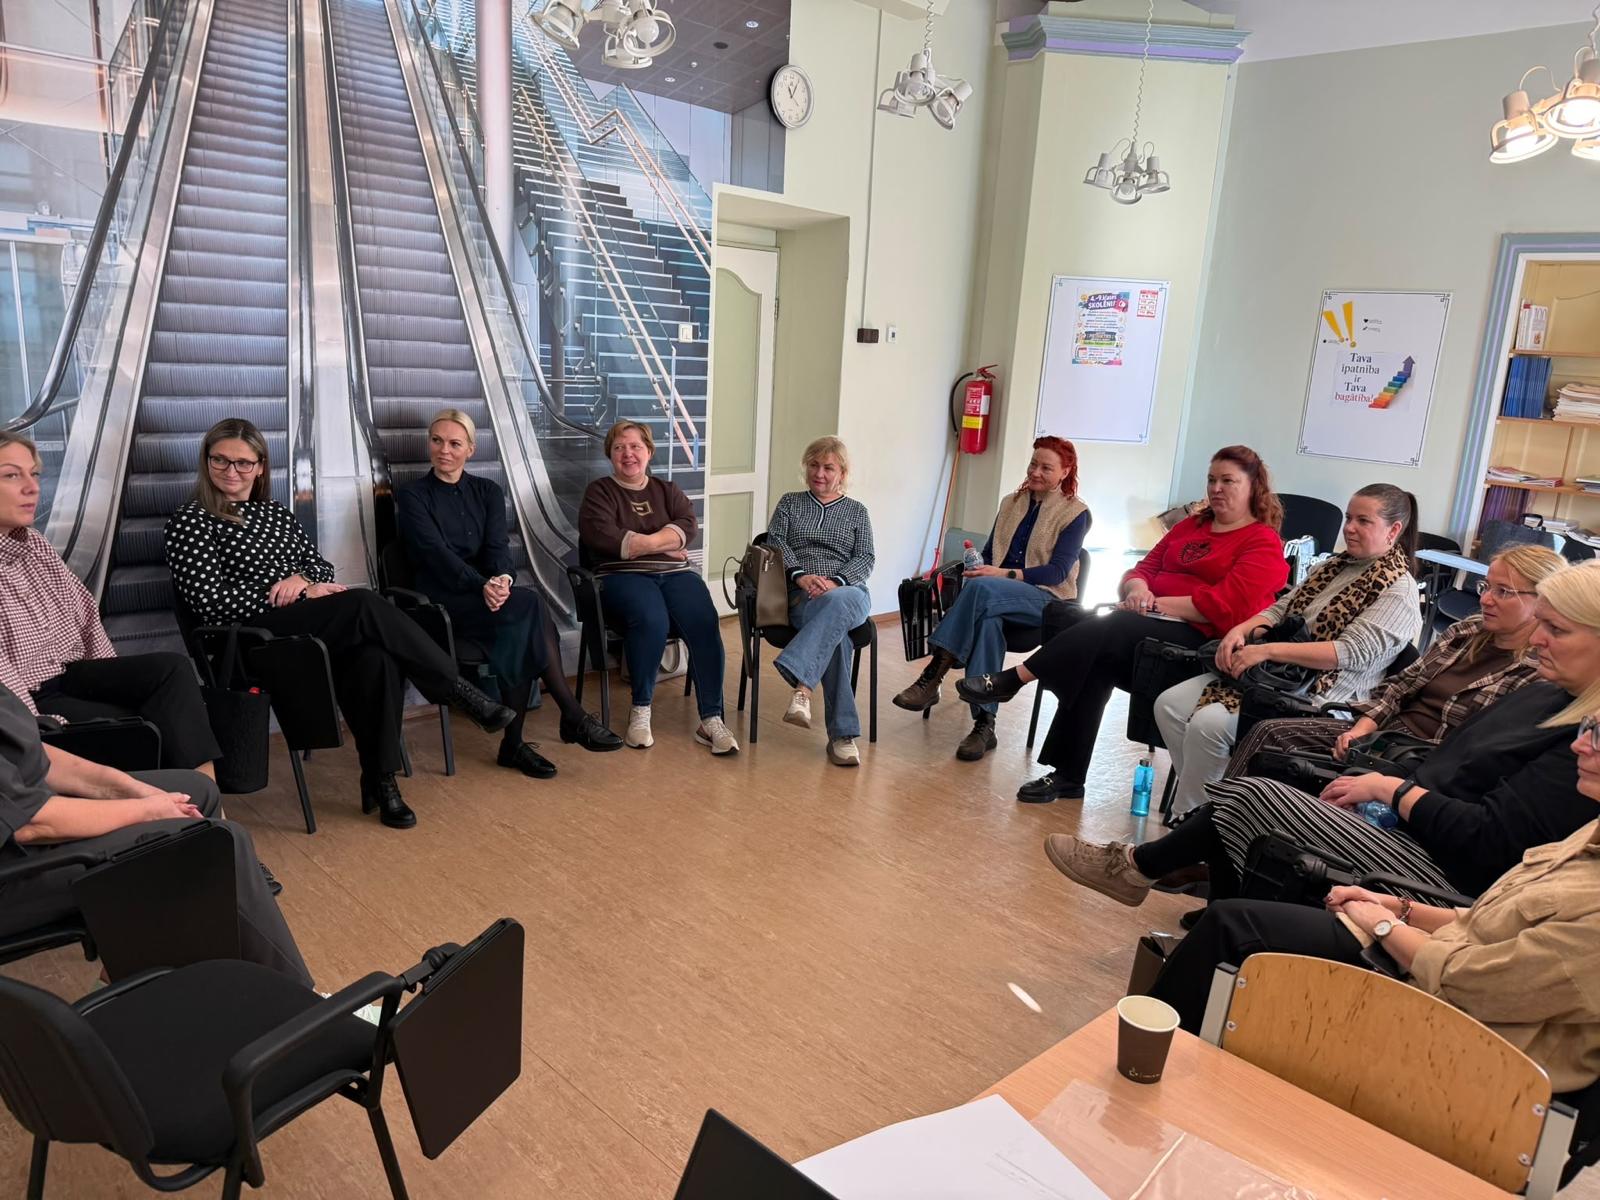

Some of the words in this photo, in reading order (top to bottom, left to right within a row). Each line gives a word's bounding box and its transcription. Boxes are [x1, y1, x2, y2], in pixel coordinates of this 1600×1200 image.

[1350, 352, 1372, 363] Tava
[1354, 375, 1362, 383] ir
[1344, 381, 1366, 392] Tava
